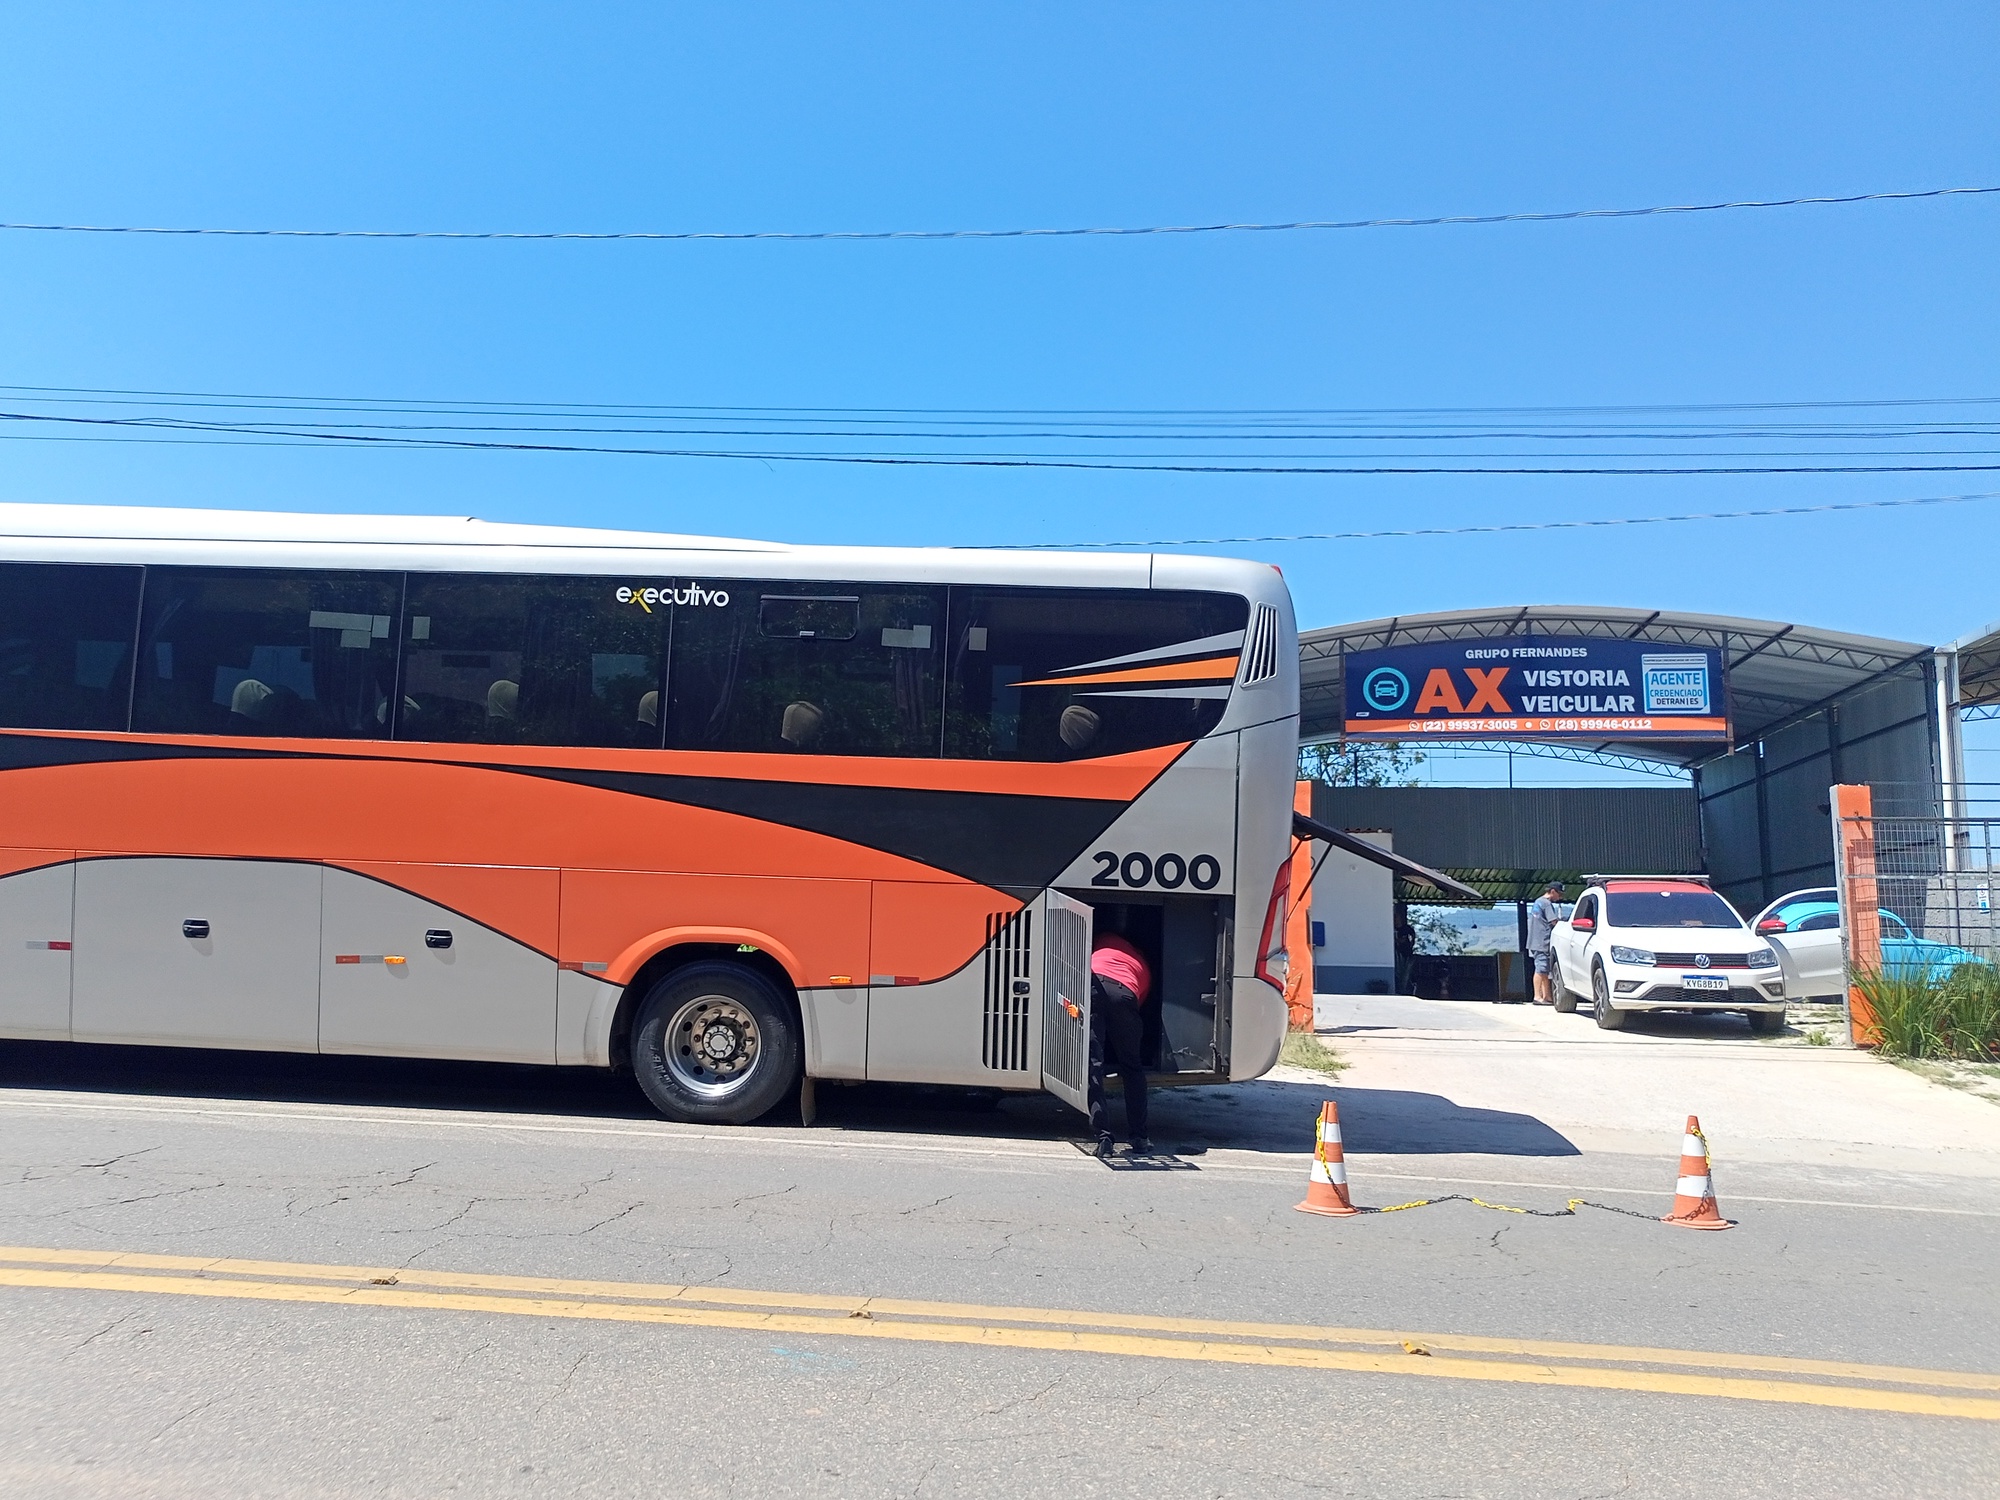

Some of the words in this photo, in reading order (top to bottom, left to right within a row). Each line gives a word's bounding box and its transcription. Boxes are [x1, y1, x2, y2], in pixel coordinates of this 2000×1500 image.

[616, 582, 729, 613] executivo
[1465, 648, 1509, 659] GRUPO
[1512, 647, 1588, 658] FERNANDES
[1523, 670, 1630, 687] VISTORIA
[1651, 672, 1701, 685] AGENTE
[1414, 667, 1513, 714] AX
[1650, 689, 1703, 697] CREDENCIADO
[1521, 695, 1635, 712] VEICULAR
[1422, 721, 1445, 732] (22)
[1447, 720, 1517, 730] 99937-3005
[1554, 719, 1578, 731] (28)
[1580, 719, 1652, 729] 99946-0112
[1091, 851, 1221, 890] 2000
[1686, 980, 1723, 988] KYG8B19
